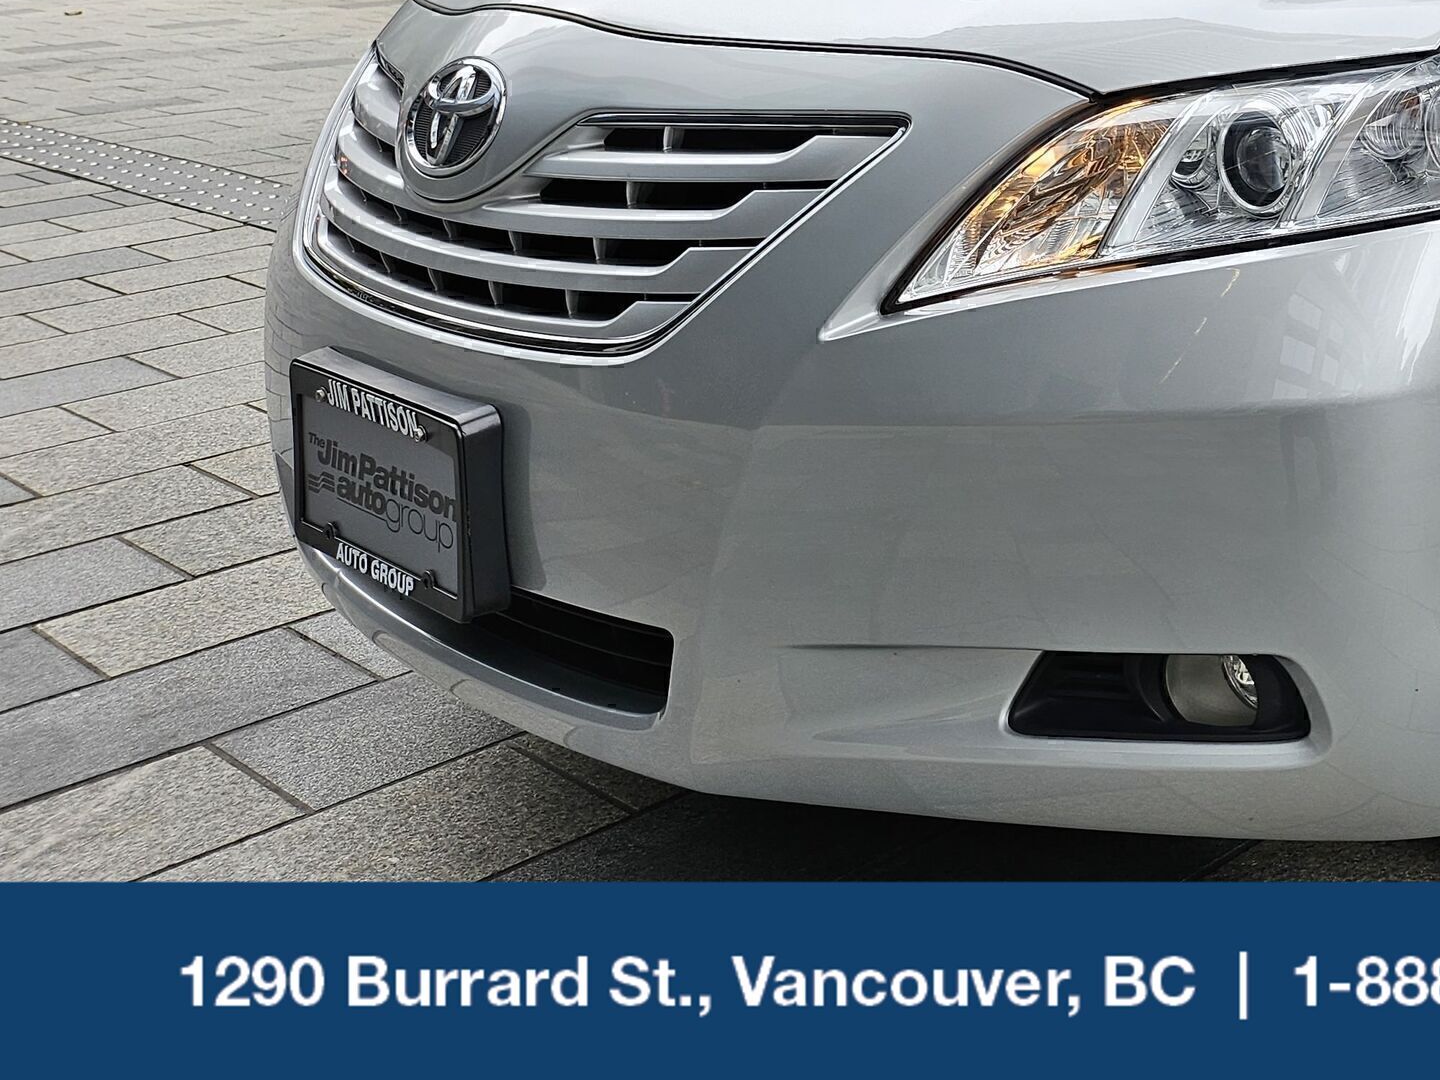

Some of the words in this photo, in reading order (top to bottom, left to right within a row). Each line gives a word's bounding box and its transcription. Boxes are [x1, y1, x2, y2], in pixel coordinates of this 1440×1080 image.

[326, 378, 351, 411] JIM
[352, 387, 420, 438] PATTISON
[308, 431, 326, 449] The
[336, 542, 369, 574] AUTO
[370, 558, 415, 597] GROUP
